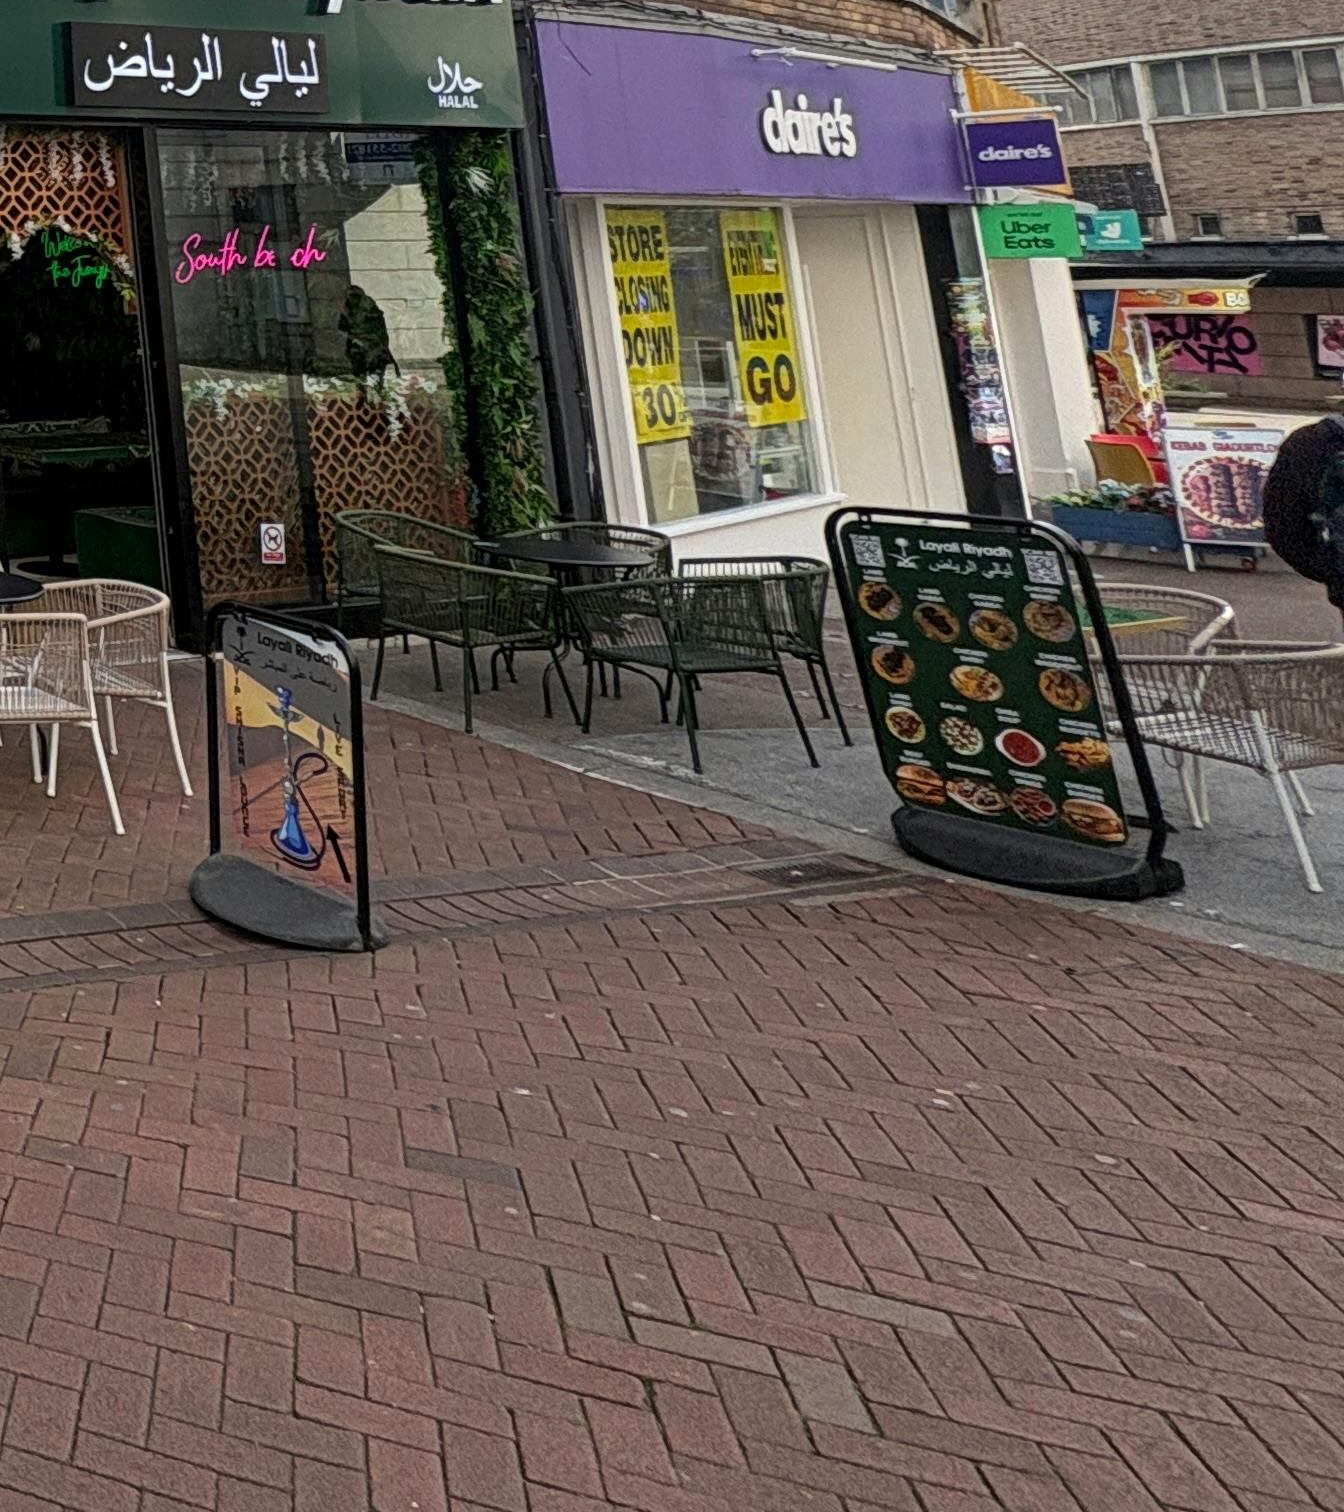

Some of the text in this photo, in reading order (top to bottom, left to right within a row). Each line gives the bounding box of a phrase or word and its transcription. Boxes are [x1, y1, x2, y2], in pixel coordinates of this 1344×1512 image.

[82, 33, 321, 107] ليالي الرياض
[426, 55, 485, 94] حلال
[438, 94, 480, 109] HALAL
[763, 90, 857, 158] claire's
[977, 143, 1053, 162] claire's
[606, 224, 665, 264] STORE
[1000, 220, 1052, 235] Uber
[1004, 235, 1056, 250] Eats
[175, 227, 247, 285] South
[735, 292, 788, 342] MUST
[621, 326, 675, 368] DOWN
[746, 353, 797, 406] GO
[918, 538, 1013, 558] Layali Riyadh
[257, 631, 292, 654] Layali
[295, 643, 339, 669] Riyadh
